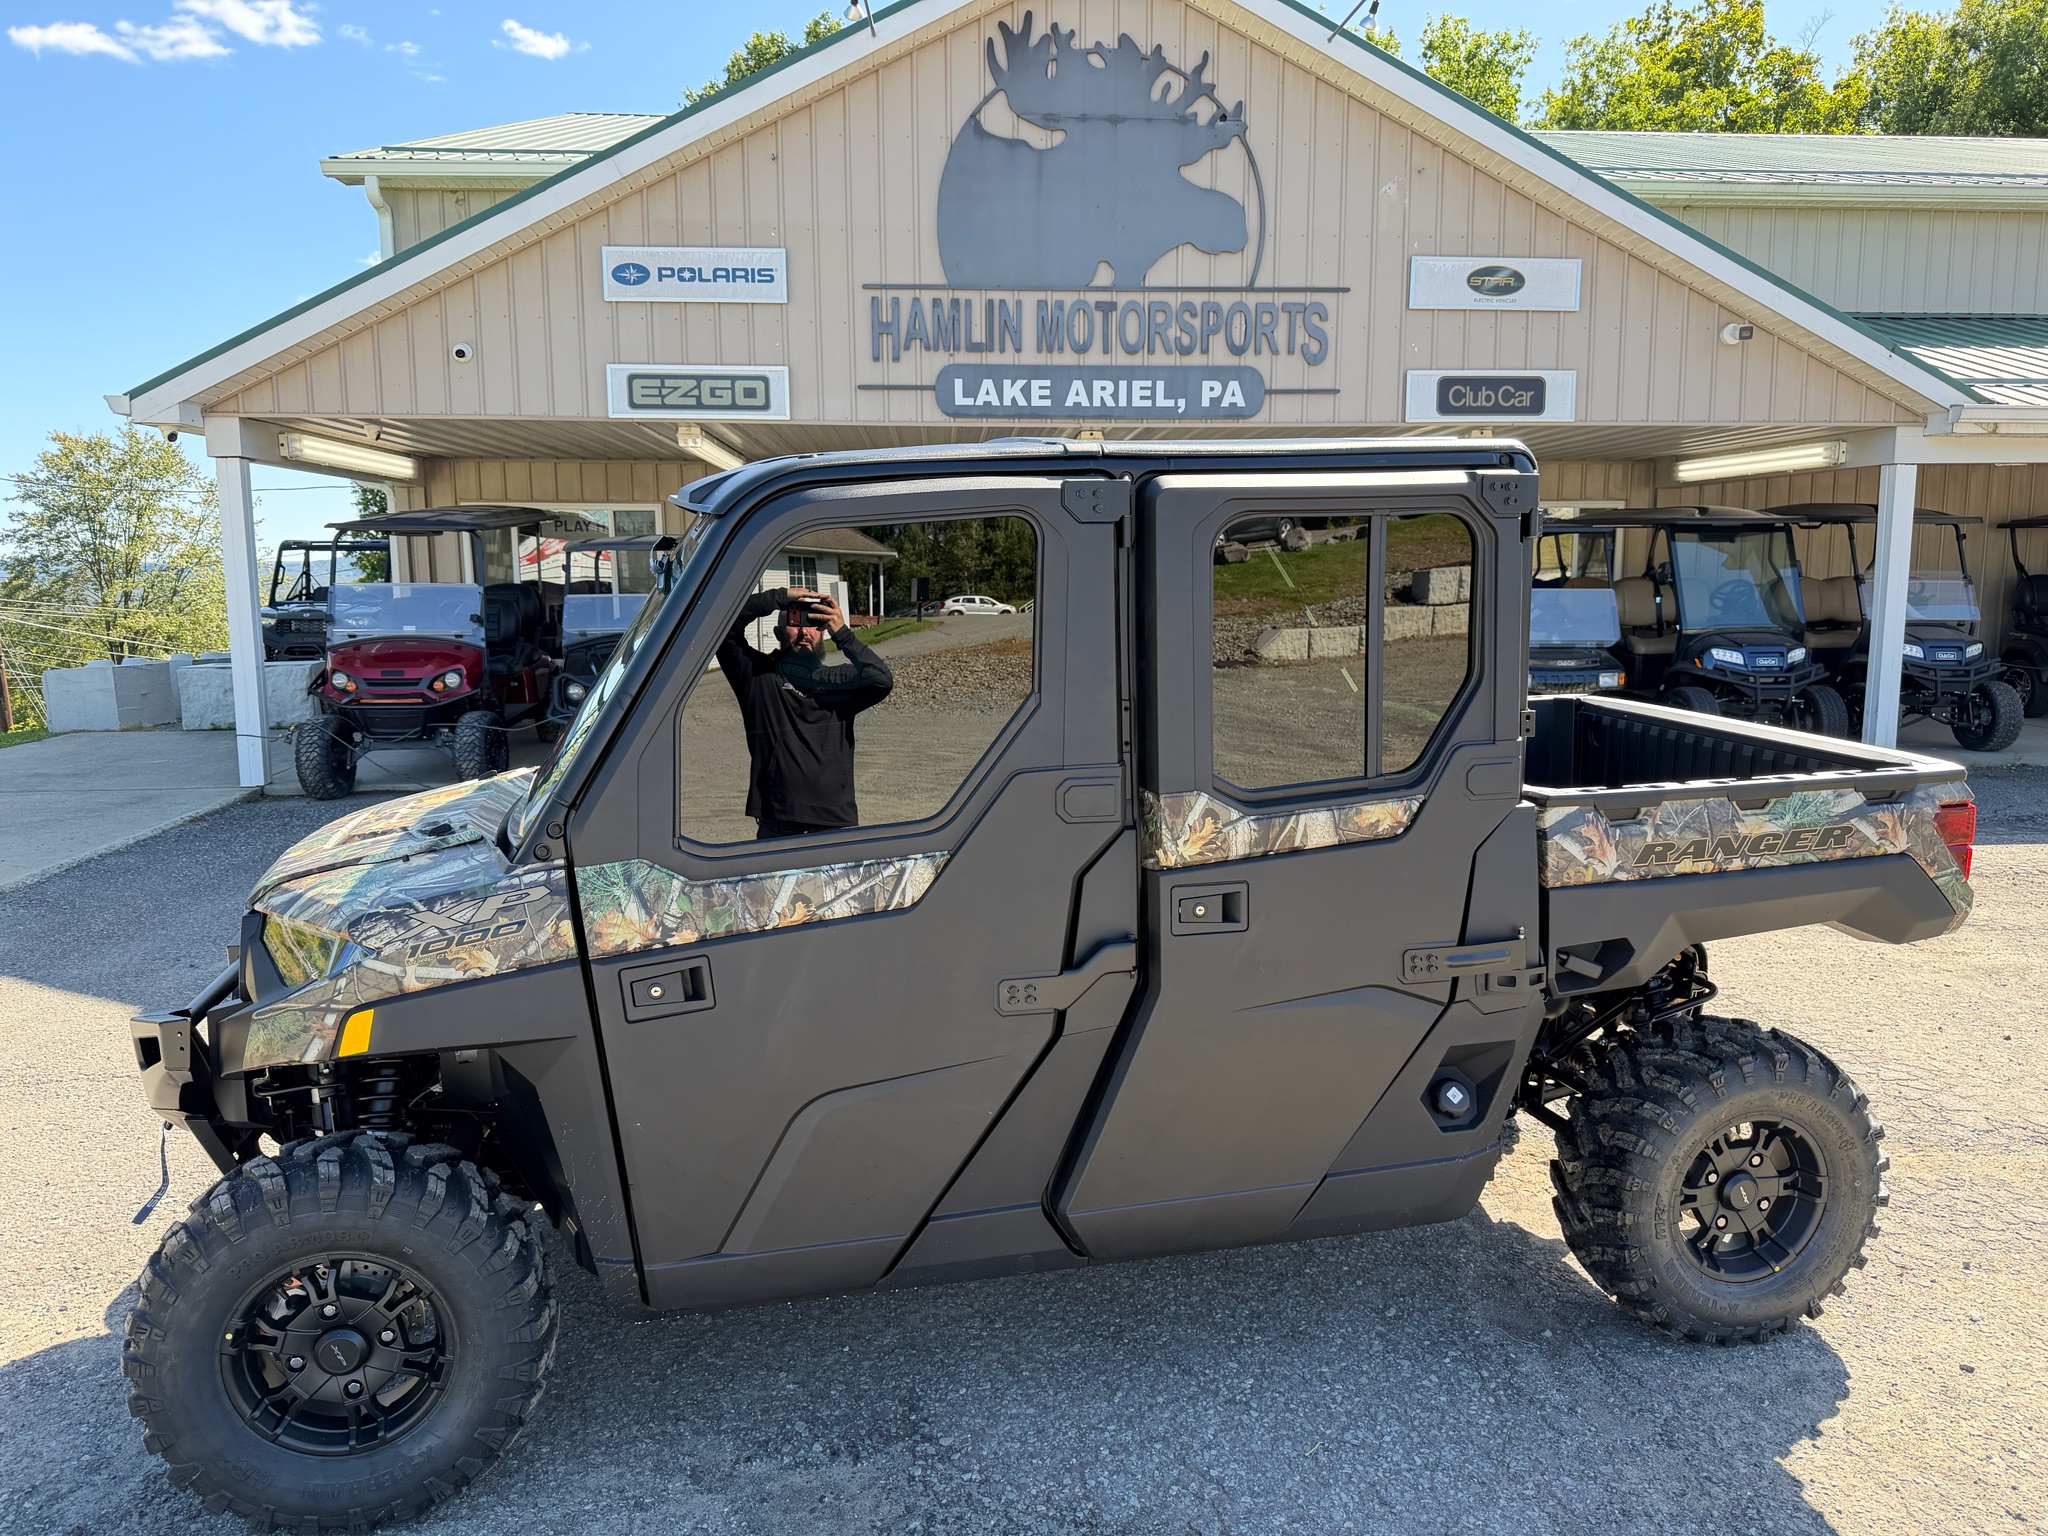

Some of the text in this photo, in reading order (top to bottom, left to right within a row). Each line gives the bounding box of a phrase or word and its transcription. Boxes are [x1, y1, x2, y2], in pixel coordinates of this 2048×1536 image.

[657, 266, 775, 284] POLARIS
[1469, 276, 1515, 287] STAR
[870, 295, 1329, 367] HAMLIN MOTORSPORTS
[631, 378, 766, 407] EZGO
[953, 377, 1246, 414] LAKE ARIEL, PA
[1448, 385, 1535, 407] Club Car
[554, 520, 592, 533] PLAY
[1631, 824, 1855, 867] RANGER
[387, 884, 552, 943] XP
[405, 918, 529, 961] 1000
